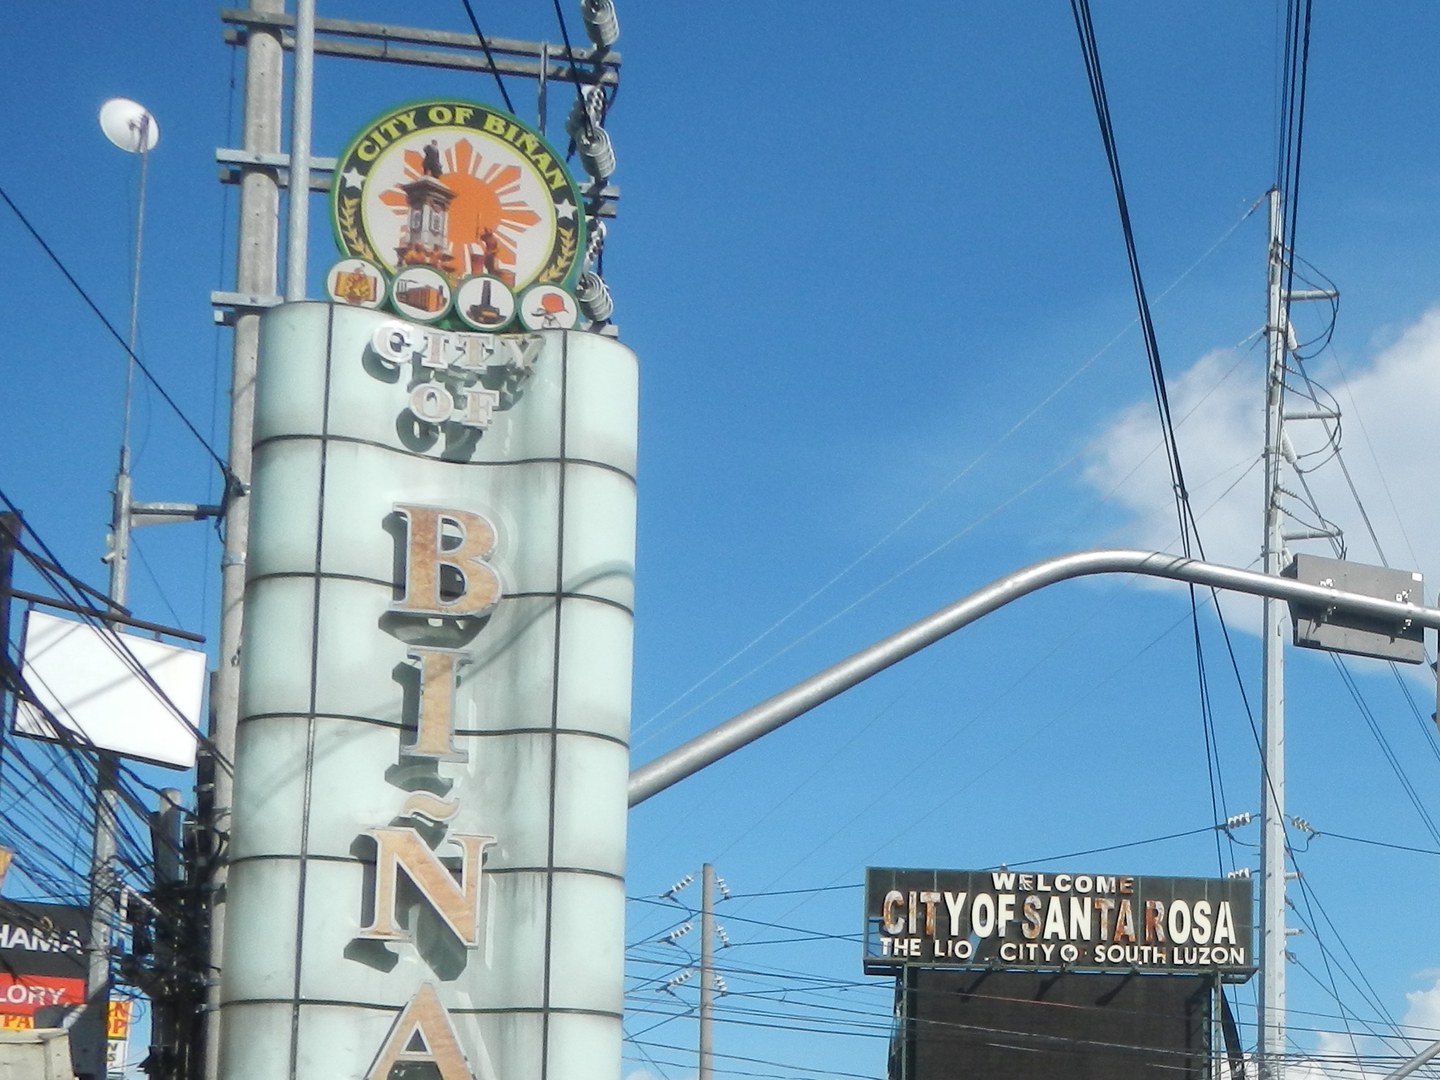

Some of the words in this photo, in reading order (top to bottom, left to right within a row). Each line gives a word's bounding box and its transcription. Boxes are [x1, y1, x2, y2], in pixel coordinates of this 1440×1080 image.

[357, 111, 417, 161] CITY
[427, 106, 475, 125] OF
[371, 321, 544, 370] CITY
[408, 382, 500, 430] OF
[992, 872, 1134, 894] WELCOME
[883, 890, 967, 938] CITY
[971, 893, 1016, 938] OF
[1022, 895, 1136, 943] SANTA
[1145, 899, 1237, 944] ROSA
[880, 938, 921, 958] THE
[1000, 943, 1056, 963] CITY
[1094, 944, 1168, 965] SOUTH
[1173, 946, 1246, 966] LUZON
[0, 983, 66, 1006] ORY
